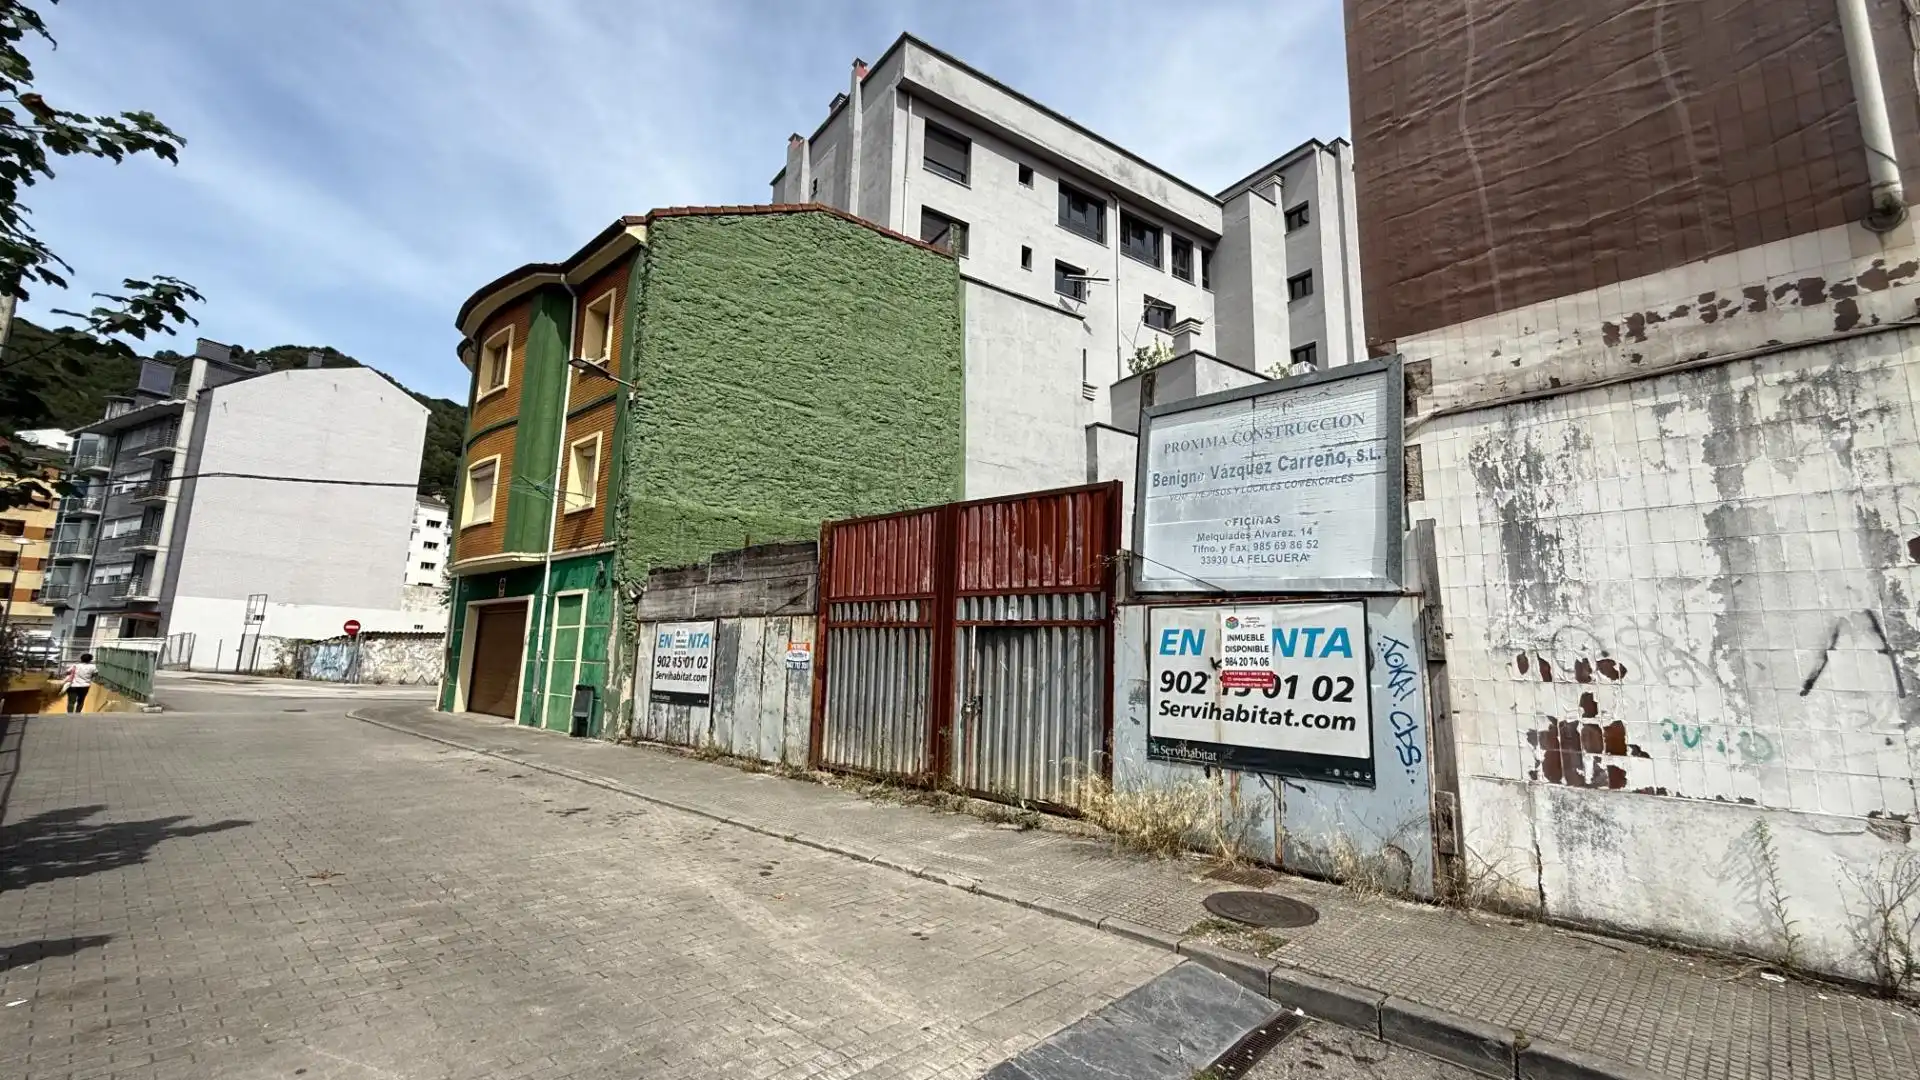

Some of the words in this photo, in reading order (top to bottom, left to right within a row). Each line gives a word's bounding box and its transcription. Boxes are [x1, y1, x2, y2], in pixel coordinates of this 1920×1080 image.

[1164, 435, 1228, 454] PROXIMA
[1232, 412, 1365, 444] CONSTRUCCION
[1153, 469, 1205, 488] Benigno
[1210, 461, 1272, 480] Vázquez
[1278, 449, 1351, 471] Carreño,
[1356, 448, 1381, 462] S.L.
[1196, 530, 1251, 542] Melquiades
[1301, 527, 1312, 536] 14
[1221, 545, 1227, 554] y
[1253, 542, 1271, 551] 985
[1274, 541, 1286, 550] 69
[1290, 540, 1302, 549] 86
[1306, 539, 1319, 549] 52
[1201, 556, 1227, 565] 33930
[1231, 555, 1244, 564] LA
[1247, 553, 1308, 564] FELGUERA
[658, 634, 672, 648] EN
[687, 633, 710, 648] NTA
[1159, 629, 1206, 656] EN
[1271, 627, 1353, 658] NTA
[1225, 645, 1269, 653] DISPONIBLE
[657, 655, 671, 668] 902
[684, 656, 695, 669] 01
[697, 656, 709, 669] 02
[1225, 657, 1238, 666] 984
[1239, 657, 1249, 666] 20
[1250, 657, 1259, 666] 74
[1260, 657, 1270, 666] 06
[655, 670, 708, 682] Servihabitat.com
[1159, 670, 1208, 694] 902
[1312, 675, 1355, 703] 02
[1158, 700, 1356, 731] Servihabitat.com
[1160, 745, 1217, 760] Servihabitat
